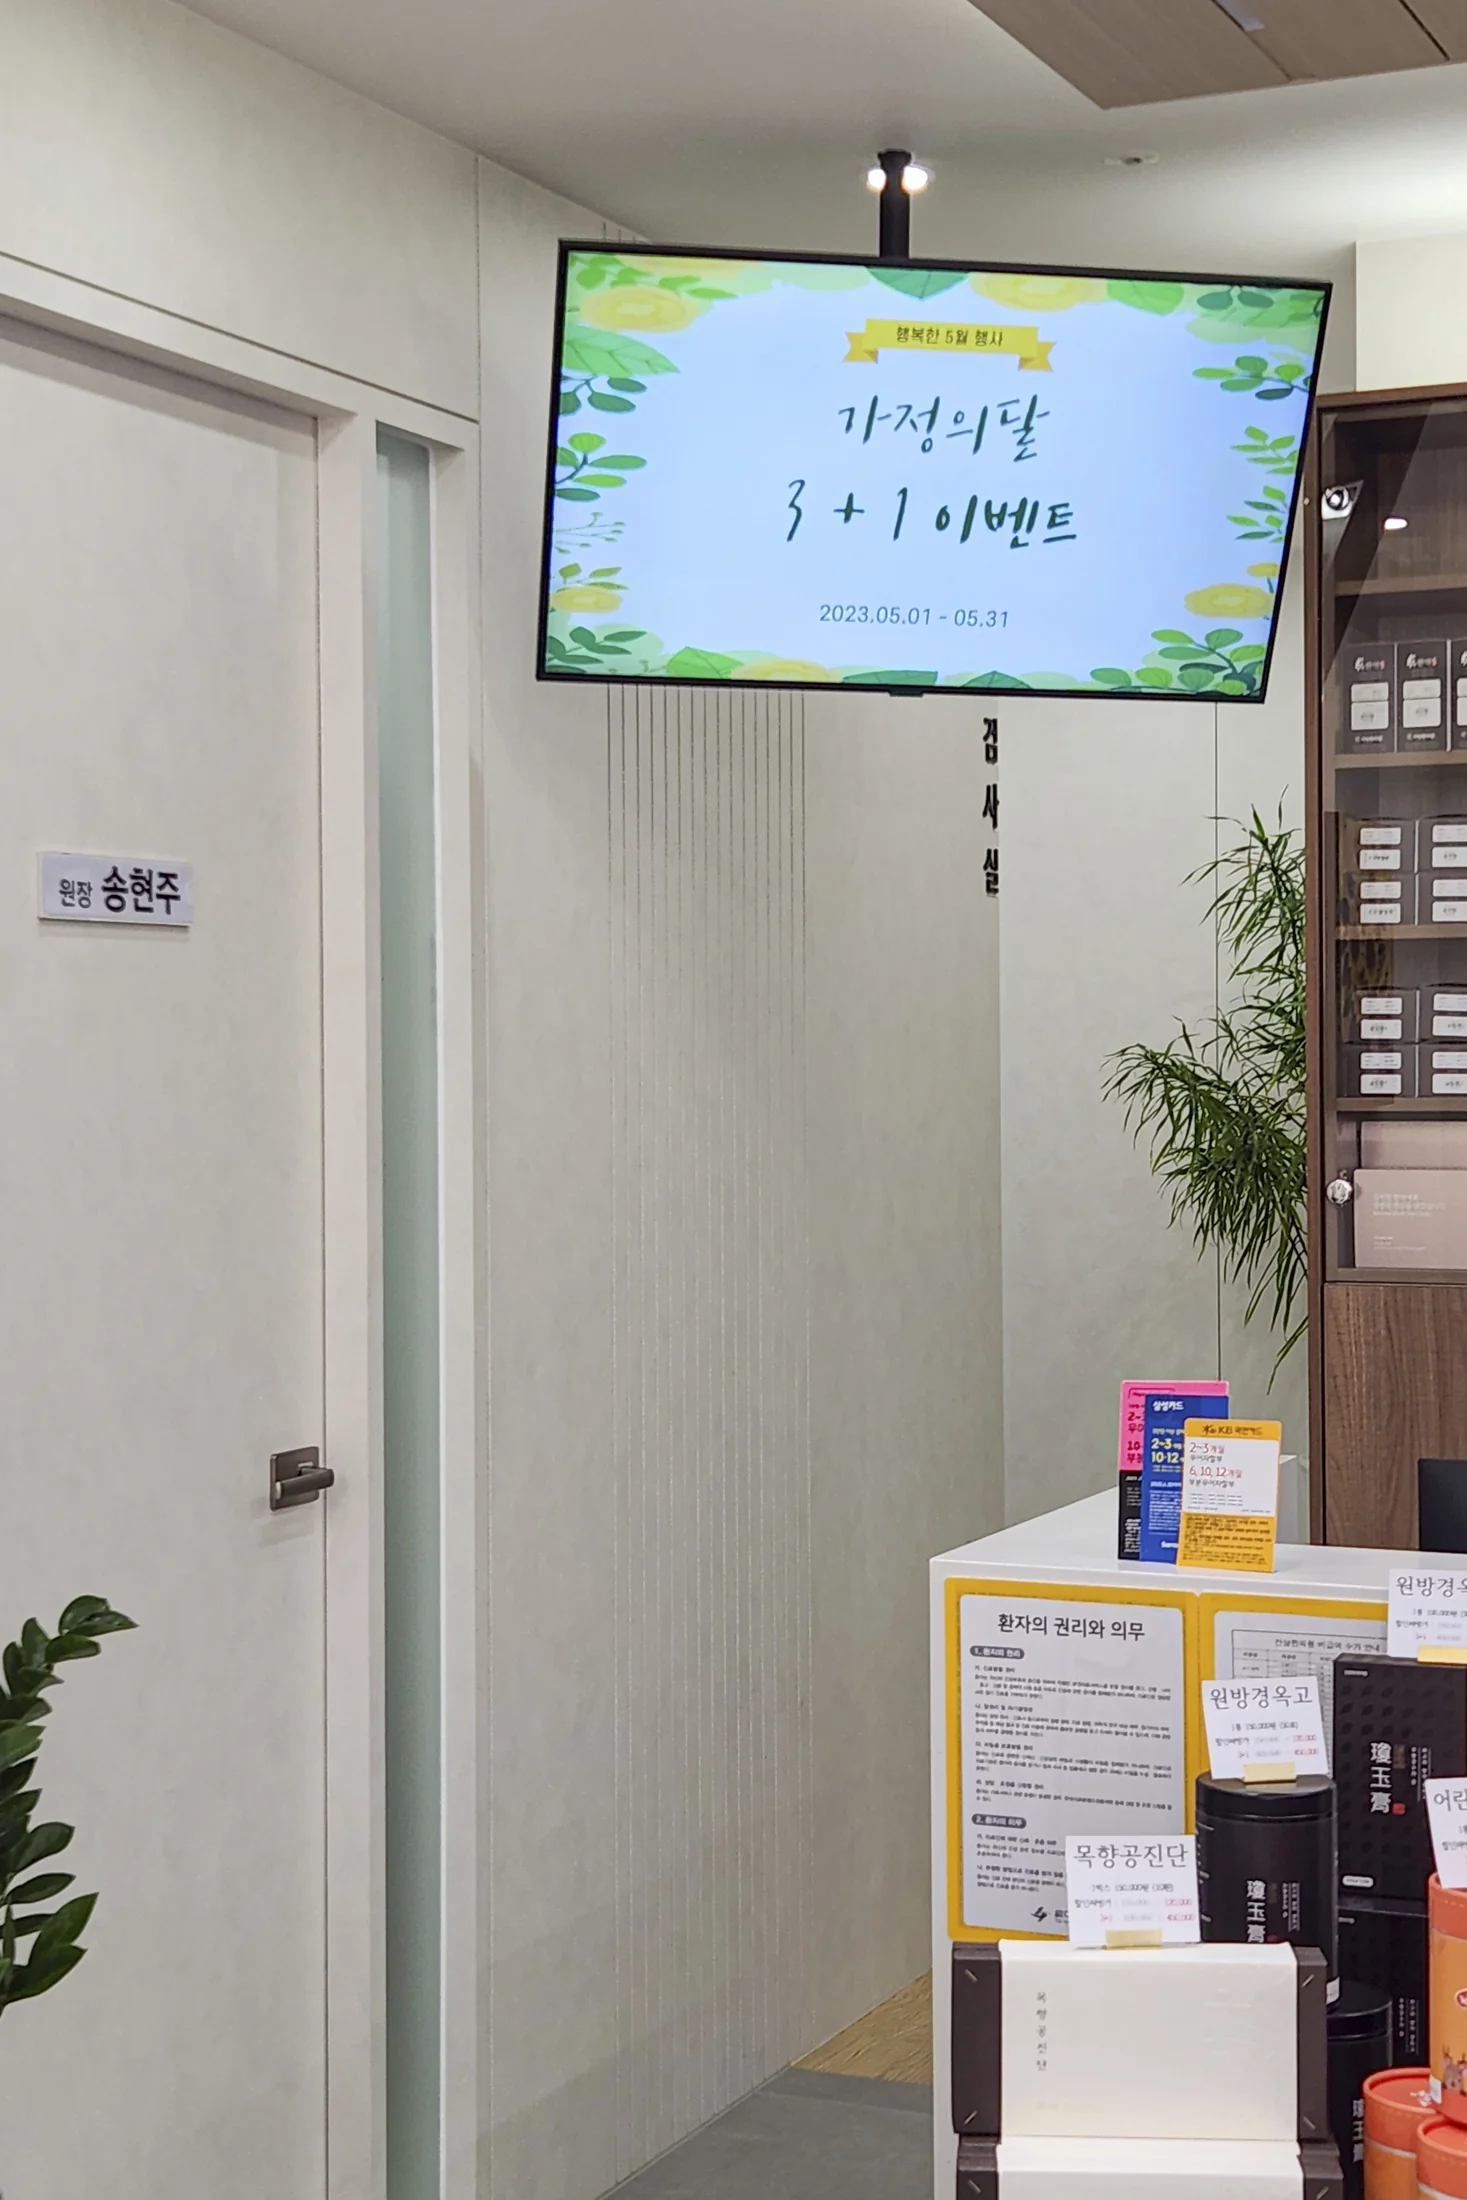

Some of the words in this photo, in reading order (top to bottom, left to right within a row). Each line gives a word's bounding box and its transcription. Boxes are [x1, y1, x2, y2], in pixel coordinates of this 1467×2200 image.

[896, 326, 939, 345] 행복한
[944, 329, 968, 346] 5월
[975, 330, 1004, 348] 행사
[786, 479, 805, 542] 3
[833, 492, 865, 524] +
[893, 487, 908, 541] 1
[935, 494, 1078, 550] 이벤트
[819, 604, 931, 626] 2023.05.01
[953, 608, 1009, 628] 05.31
[59, 878, 93, 909] 원장
[101, 865, 181, 916] 송현주
[1152, 1401, 1184, 1412] 삼성카드
[998, 1613, 1048, 1635] 환자의
[1054, 1617, 1106, 1639] 권리와
[1111, 1620, 1145, 1641] 의무
[1210, 1685, 1313, 1710] 원방경옥고
[1073, 1843, 1189, 1869] 목향공진단
